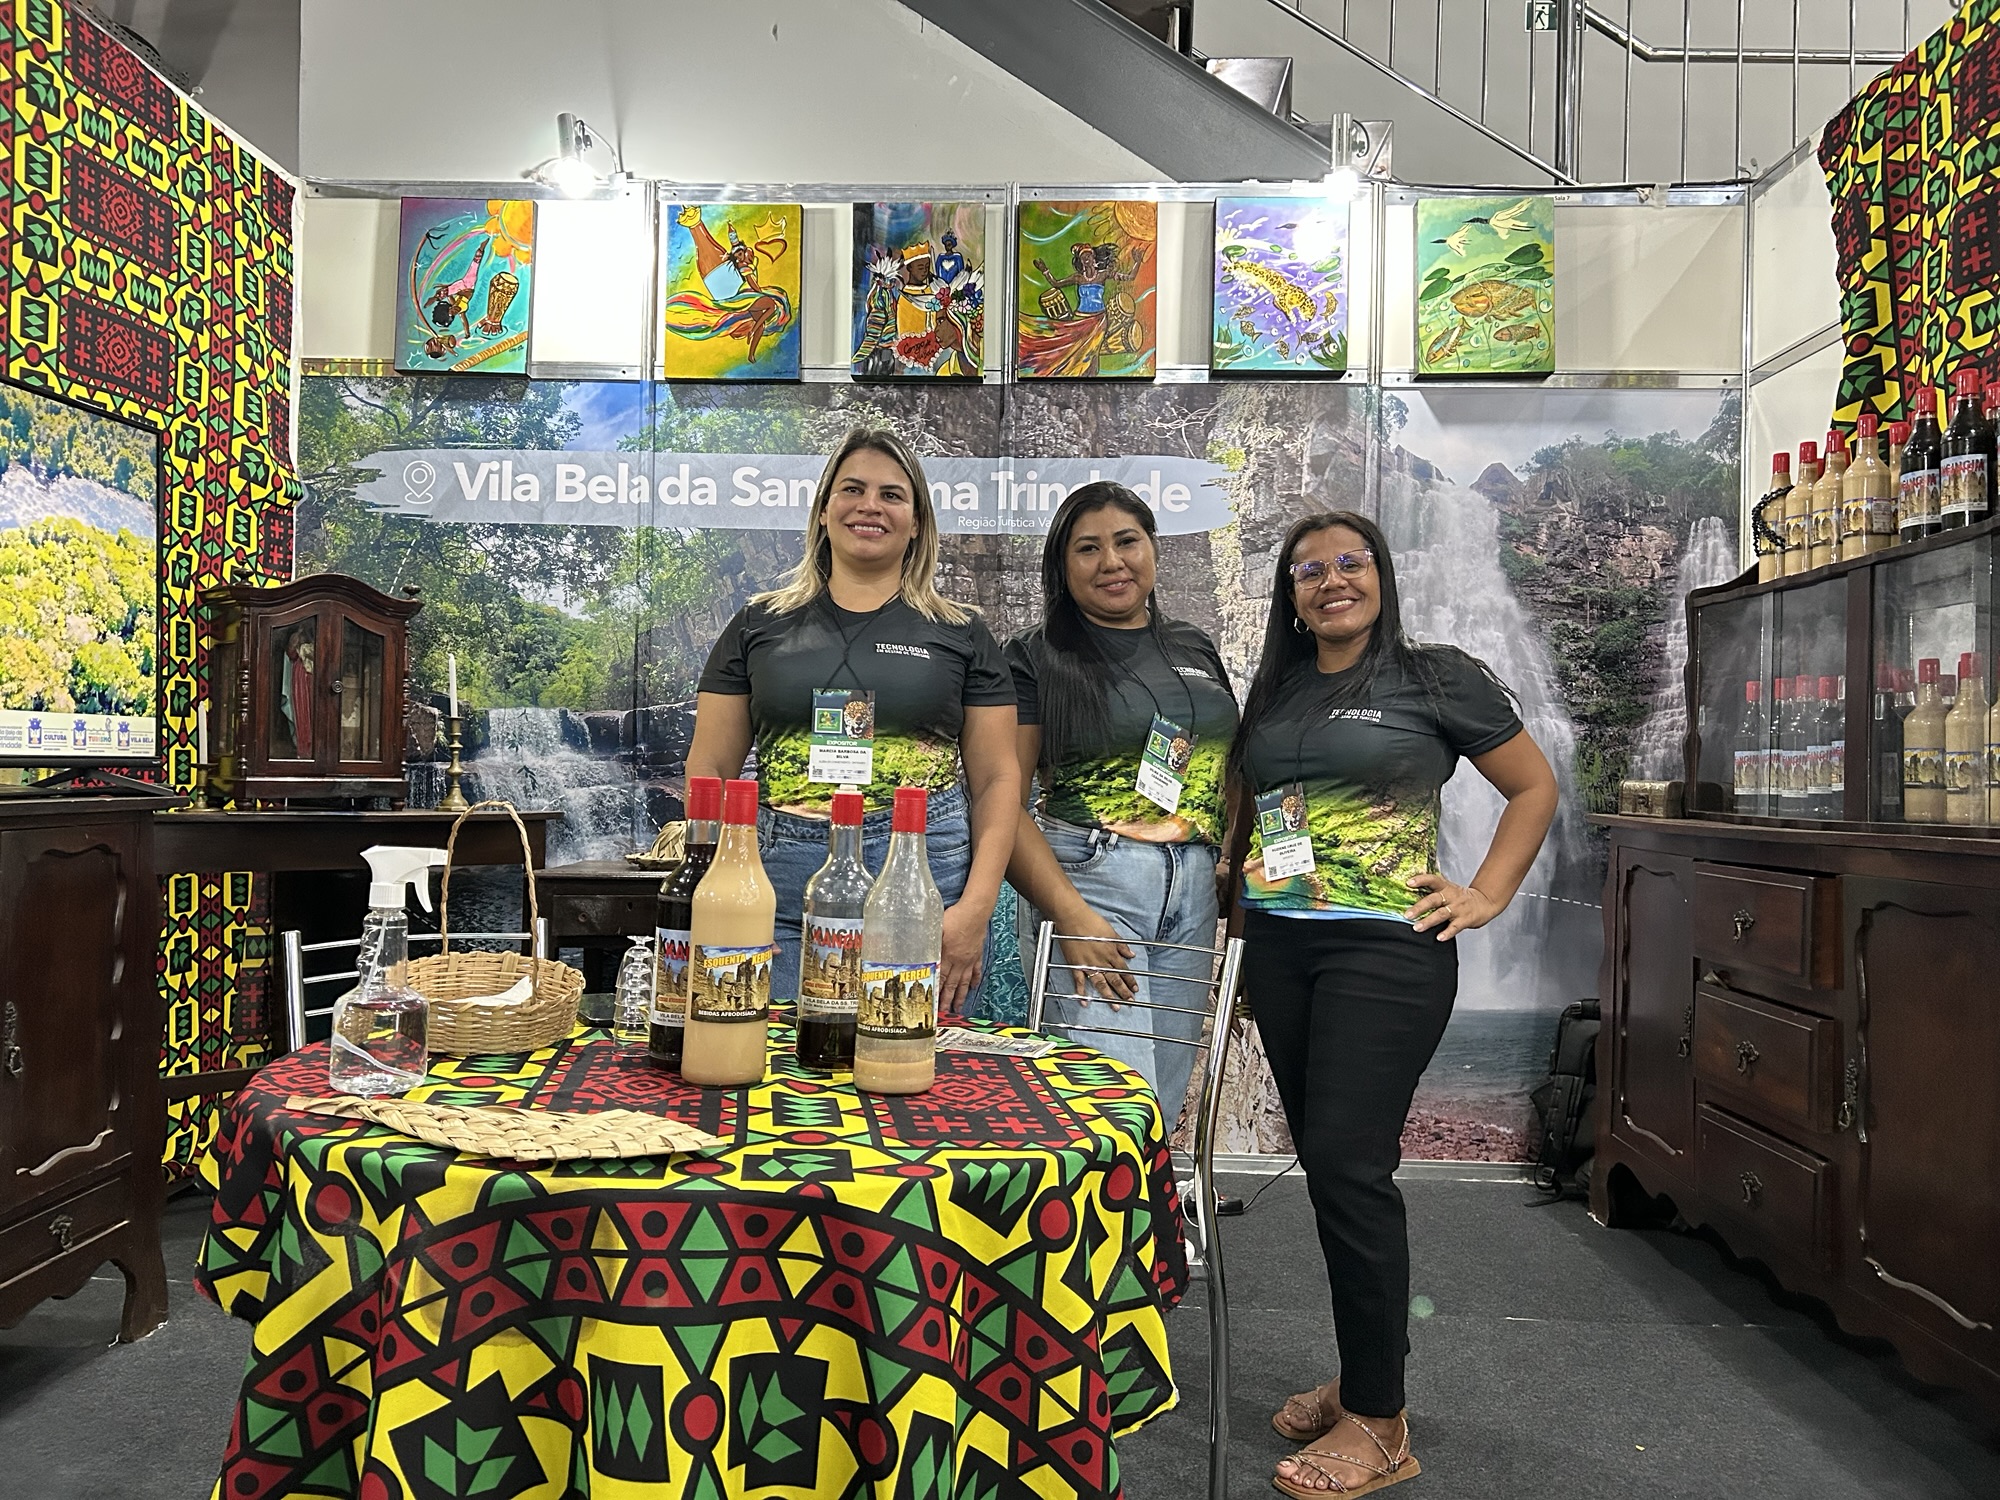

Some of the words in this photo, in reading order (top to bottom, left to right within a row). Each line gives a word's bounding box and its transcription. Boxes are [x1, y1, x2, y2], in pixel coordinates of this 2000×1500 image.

[453, 460, 541, 502] Vila
[555, 462, 650, 504] Bela
[658, 464, 717, 506] da
[991, 470, 1192, 513] Trinde
[958, 516, 996, 529] Região
[1038, 517, 1053, 528] Va
[875, 643, 930, 655] TECNOLOGIA
[703, 952, 746, 969] ESQUENTA
[698, 1009, 720, 1017] BEBIDAS
